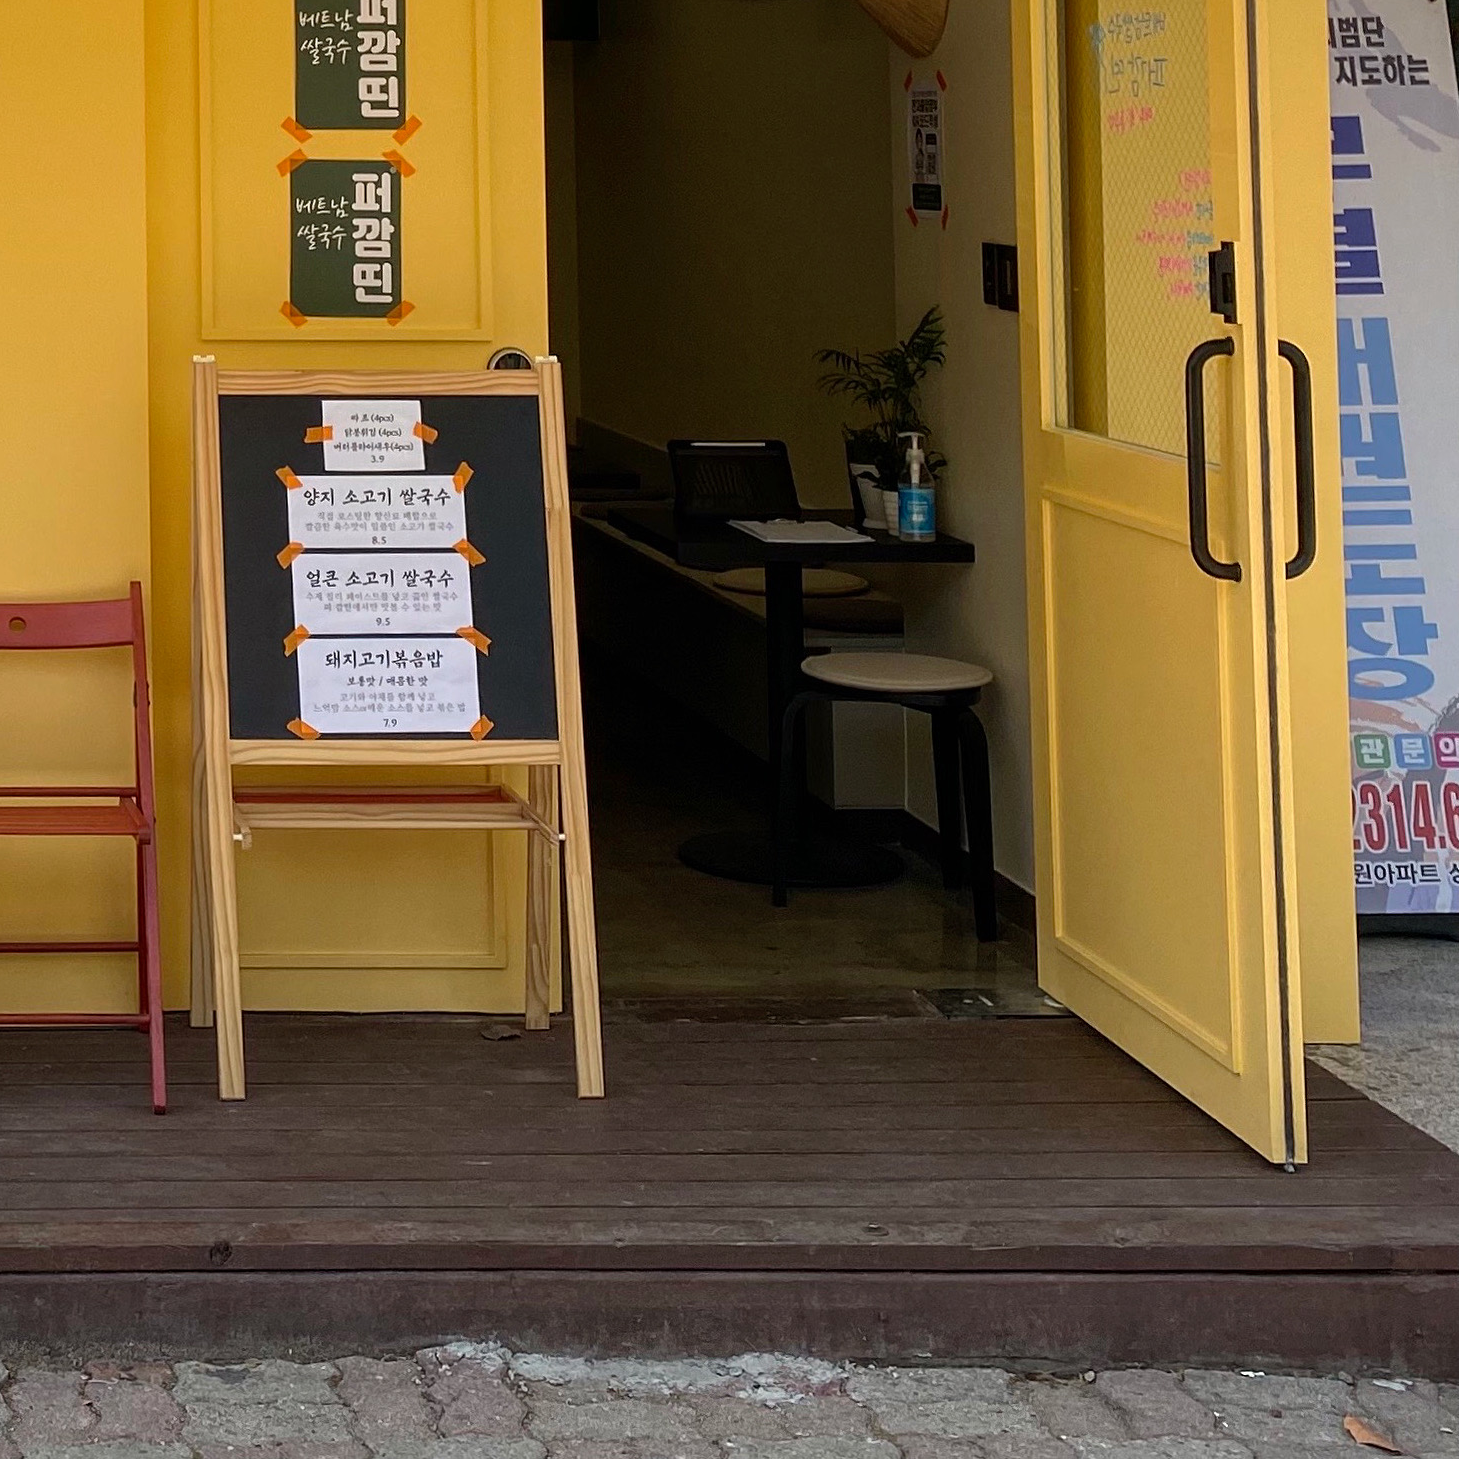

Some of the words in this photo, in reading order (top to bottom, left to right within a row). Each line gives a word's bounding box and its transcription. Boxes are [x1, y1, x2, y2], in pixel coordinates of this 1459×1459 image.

[298, 9, 354, 31] 베트남
[1328, 15, 1385, 49] 범단
[300, 37, 352, 65] 쌀국수
[1334, 53, 1431, 87] 지도하는
[295, 196, 349, 218] 베트남
[297, 224, 347, 251] 쌀국수
[351, 172, 395, 303] 퍼깜띤
[371, 455, 385, 464] 3.9
[303, 488, 335, 506] 양지
[342, 487, 392, 505] 소고기
[399, 488, 451, 506] 쌀국수
[371, 536, 387, 545] 8.5
[306, 570, 339, 588] 얼큰
[345, 569, 395, 588] 소고기
[402, 569, 455, 588] 쌀국수
[376, 617, 391, 626] 9.5
[325, 649, 443, 670] 돼지고기볶음밥
[1352, 782, 1459, 851] 314.6
